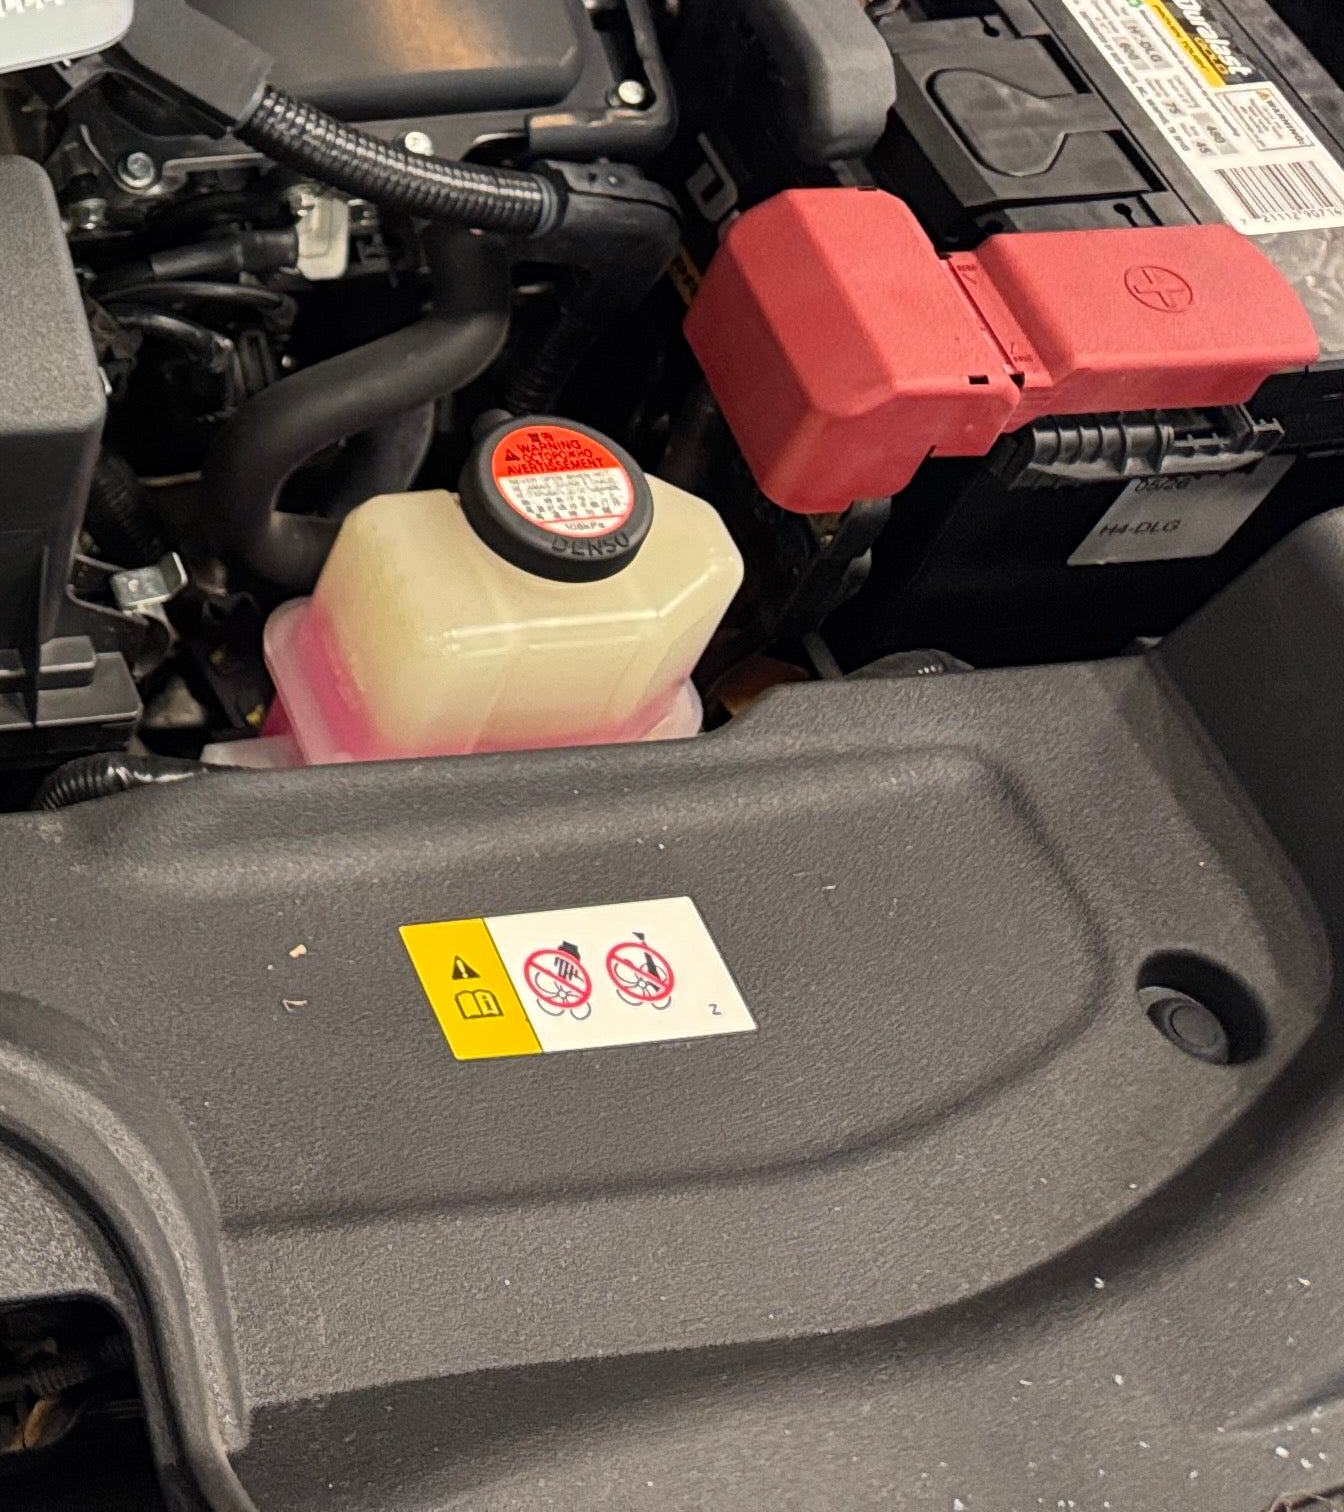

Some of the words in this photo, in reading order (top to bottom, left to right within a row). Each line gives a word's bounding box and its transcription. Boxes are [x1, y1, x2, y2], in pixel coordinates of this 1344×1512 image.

[516, 439, 582, 455] WARNING
[507, 457, 604, 477] AVERTISSEMENT
[1099, 519, 1181, 536] H4-DLG
[551, 531, 630, 558] DENSO
